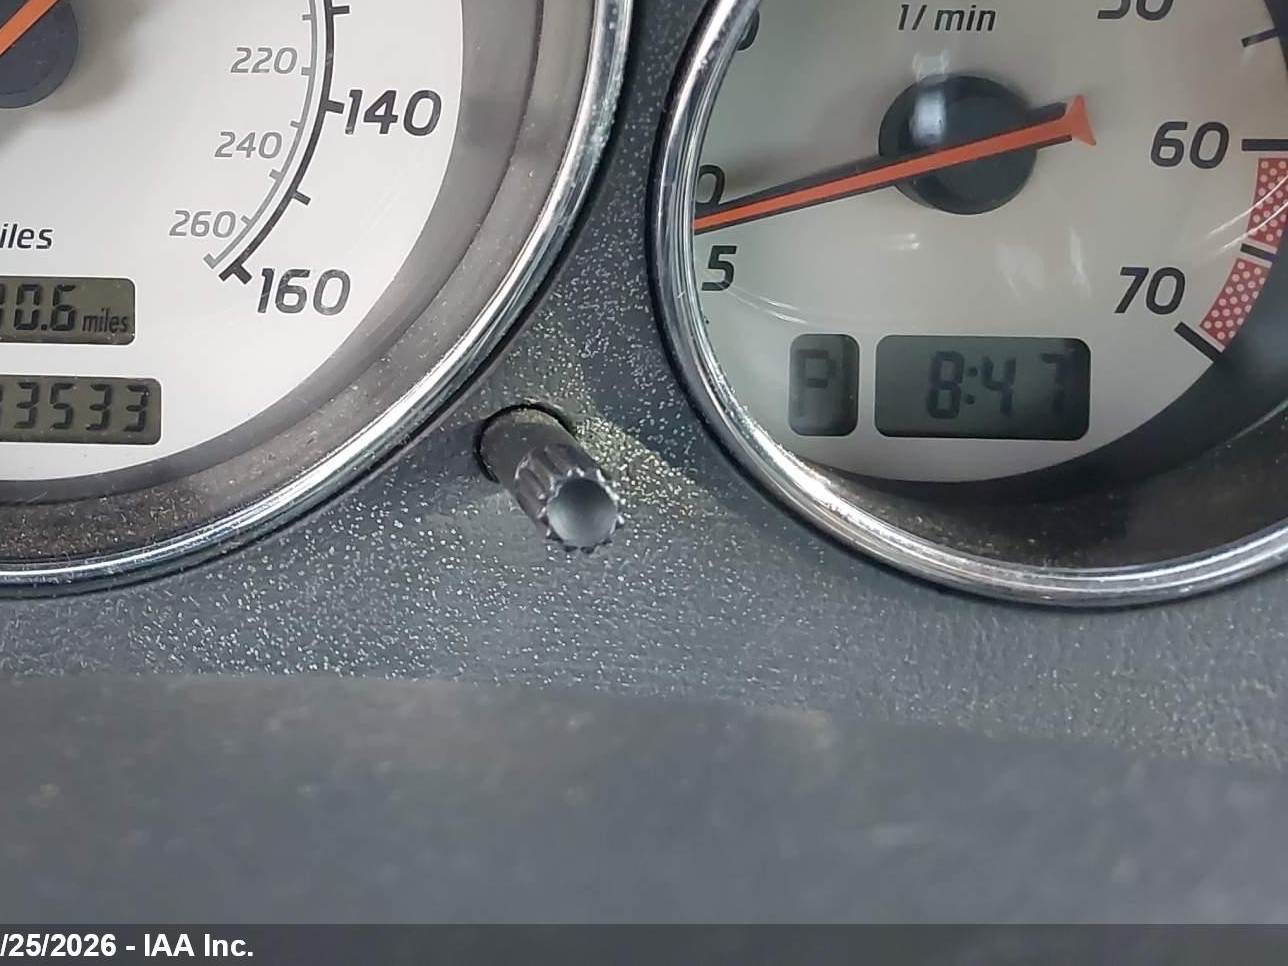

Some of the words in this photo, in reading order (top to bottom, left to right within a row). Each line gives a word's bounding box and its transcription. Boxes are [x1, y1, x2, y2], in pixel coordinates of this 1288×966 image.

[230, 47, 298, 75] 220
[344, 89, 442, 137] 140
[214, 131, 283, 159] 240
[1150, 121, 1230, 169] 60
[169, 210, 237, 238] 260
[701, 244, 738, 292] 5
[1114, 267, 1186, 315] 70
[257, 268, 351, 317] 160
[81, 307, 129, 334] miles
[795, 349, 837, 418] P
[926, 350, 1076, 420] 8:47
